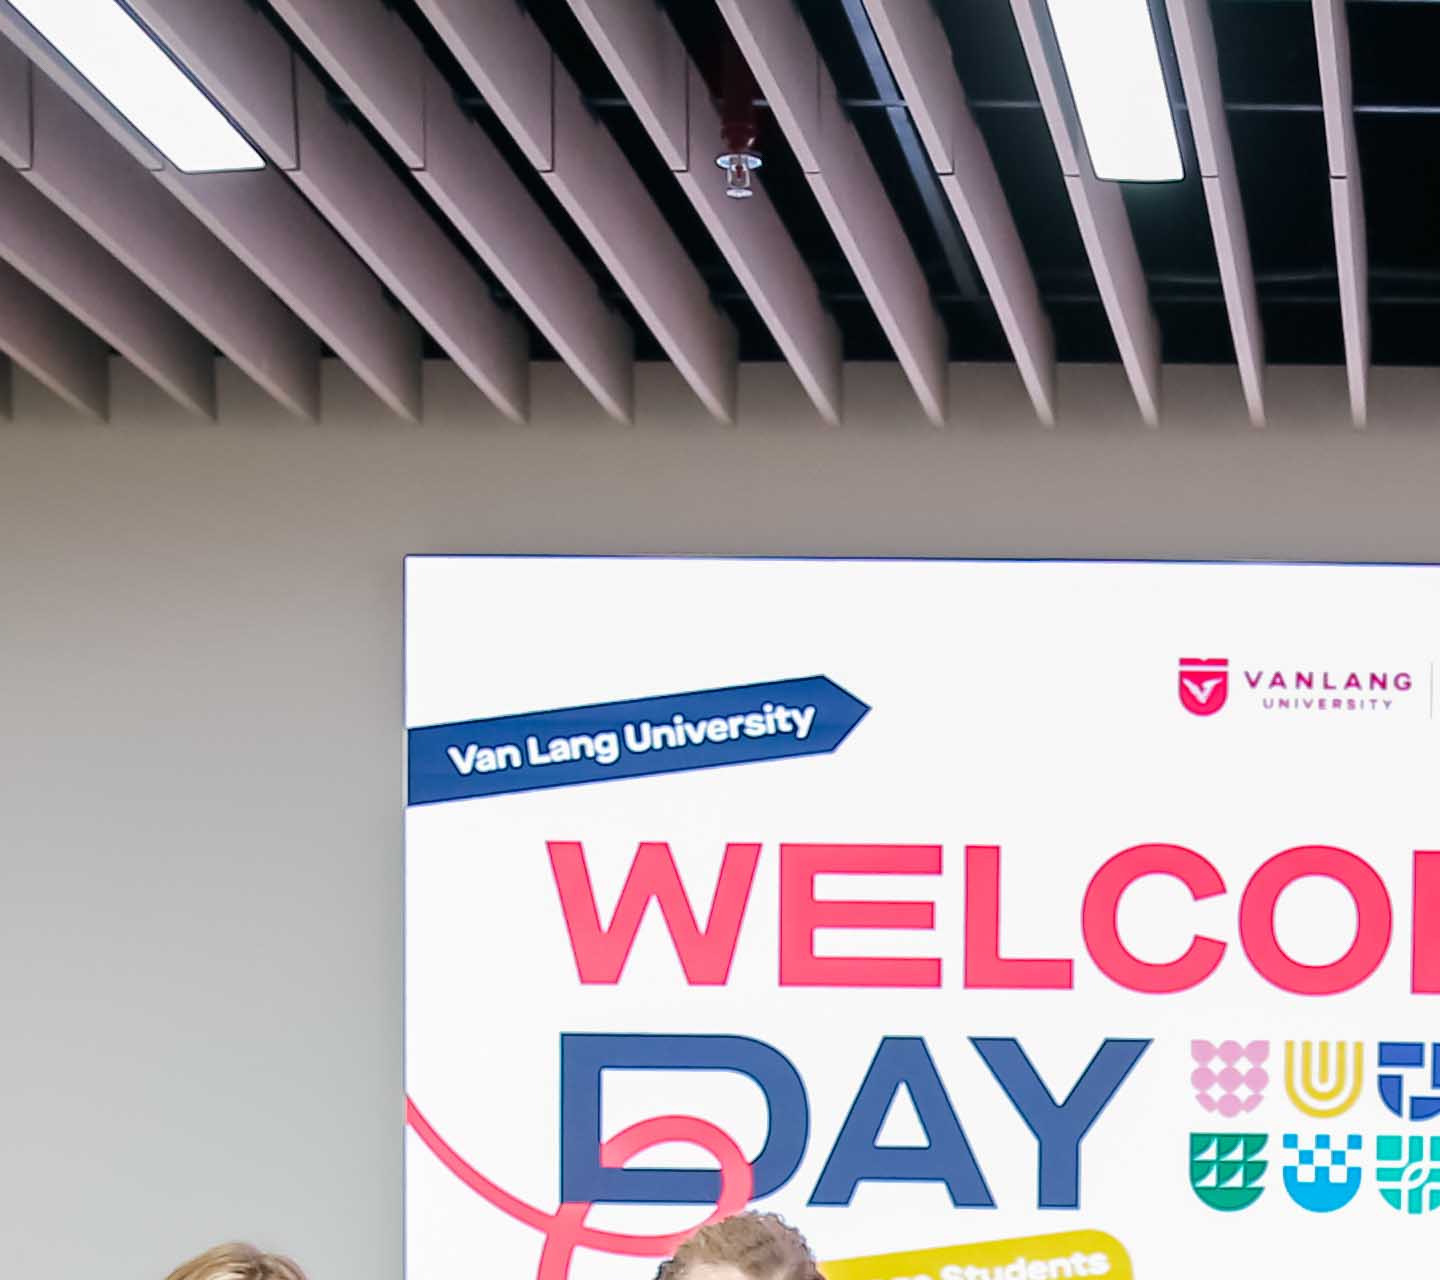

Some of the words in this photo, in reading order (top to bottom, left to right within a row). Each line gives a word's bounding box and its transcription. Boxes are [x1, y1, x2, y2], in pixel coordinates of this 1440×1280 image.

[1244, 671, 1411, 691] VANLANG
[1263, 698, 1392, 710] UNIVERSITY
[447, 744, 522, 775] Van
[526, 731, 620, 765] Lang
[623, 701, 817, 753] University
[559, 1031, 1154, 1210] DAY
